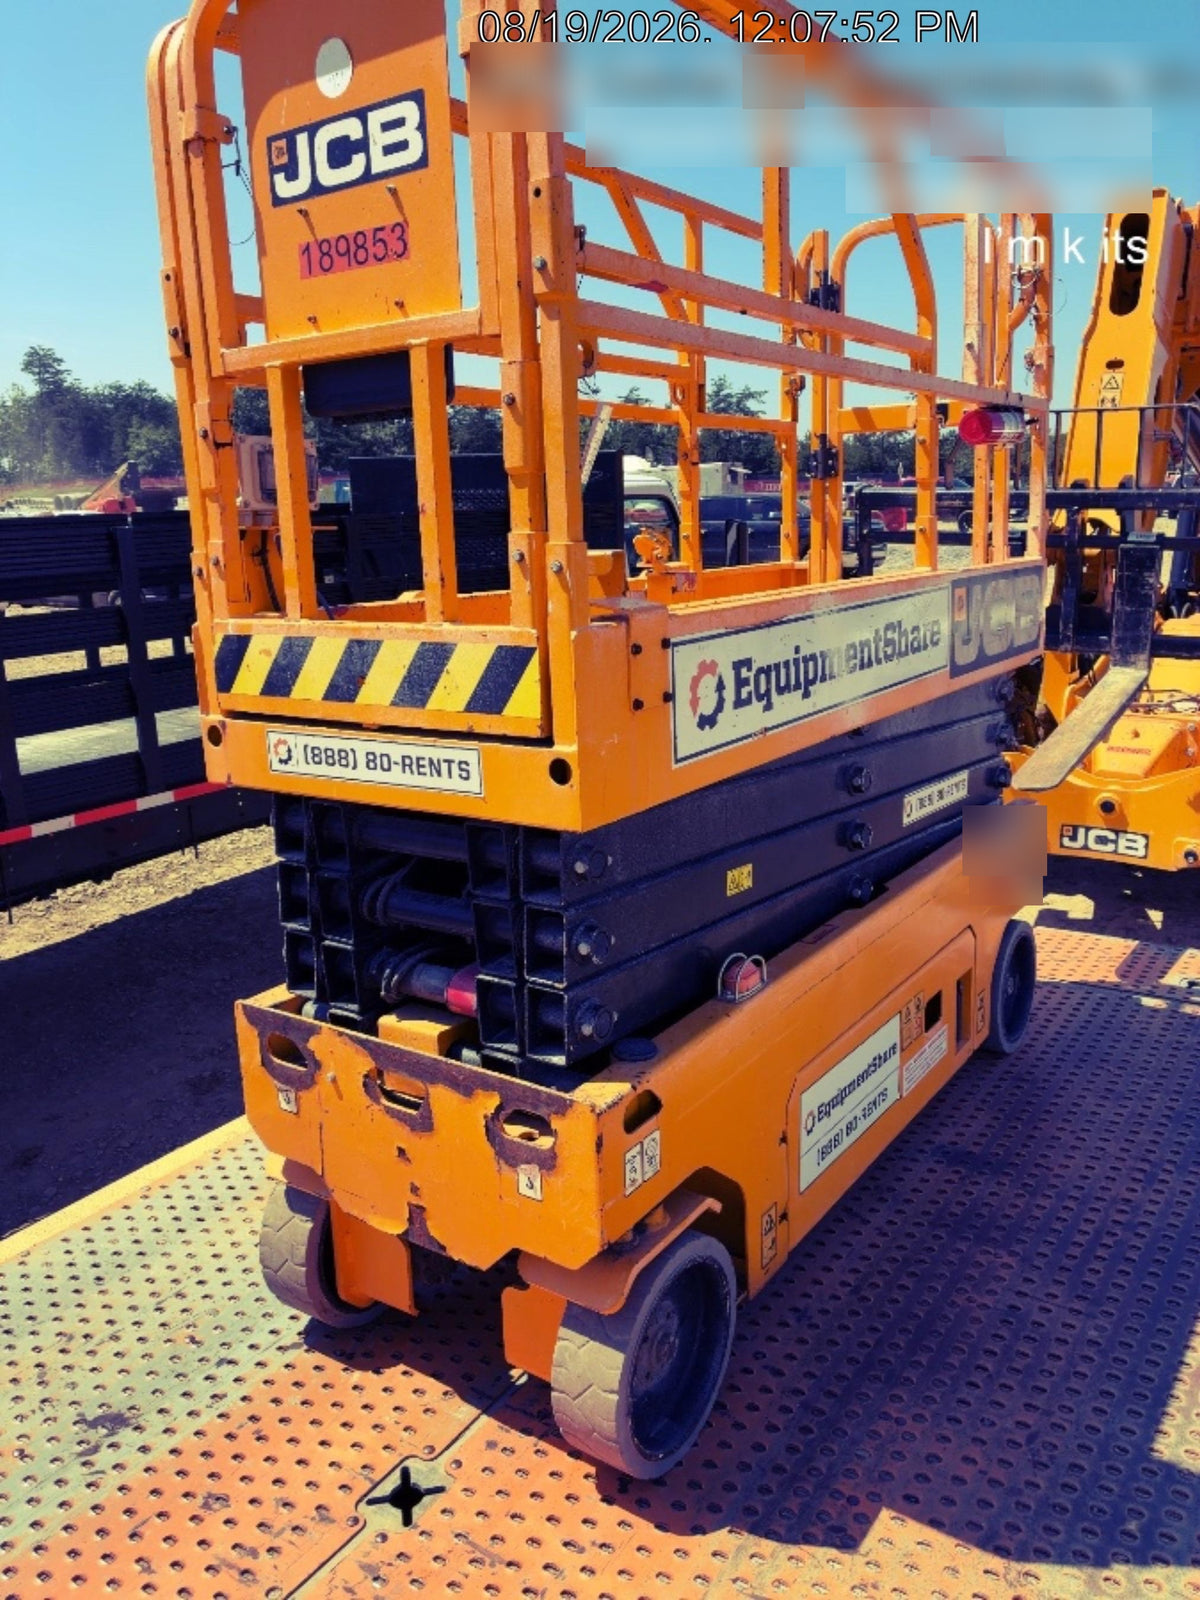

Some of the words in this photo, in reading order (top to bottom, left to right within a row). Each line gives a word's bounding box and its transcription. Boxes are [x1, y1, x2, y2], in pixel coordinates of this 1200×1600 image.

[272, 99, 425, 198] JCB
[301, 221, 408, 276] 189853
[952, 574, 1041, 666] JCB
[732, 619, 941, 713] EquipmentShare
[303, 743, 358, 771] (888)
[365, 751, 471, 781] 80-RENTS
[1061, 827, 1148, 858] JCB
